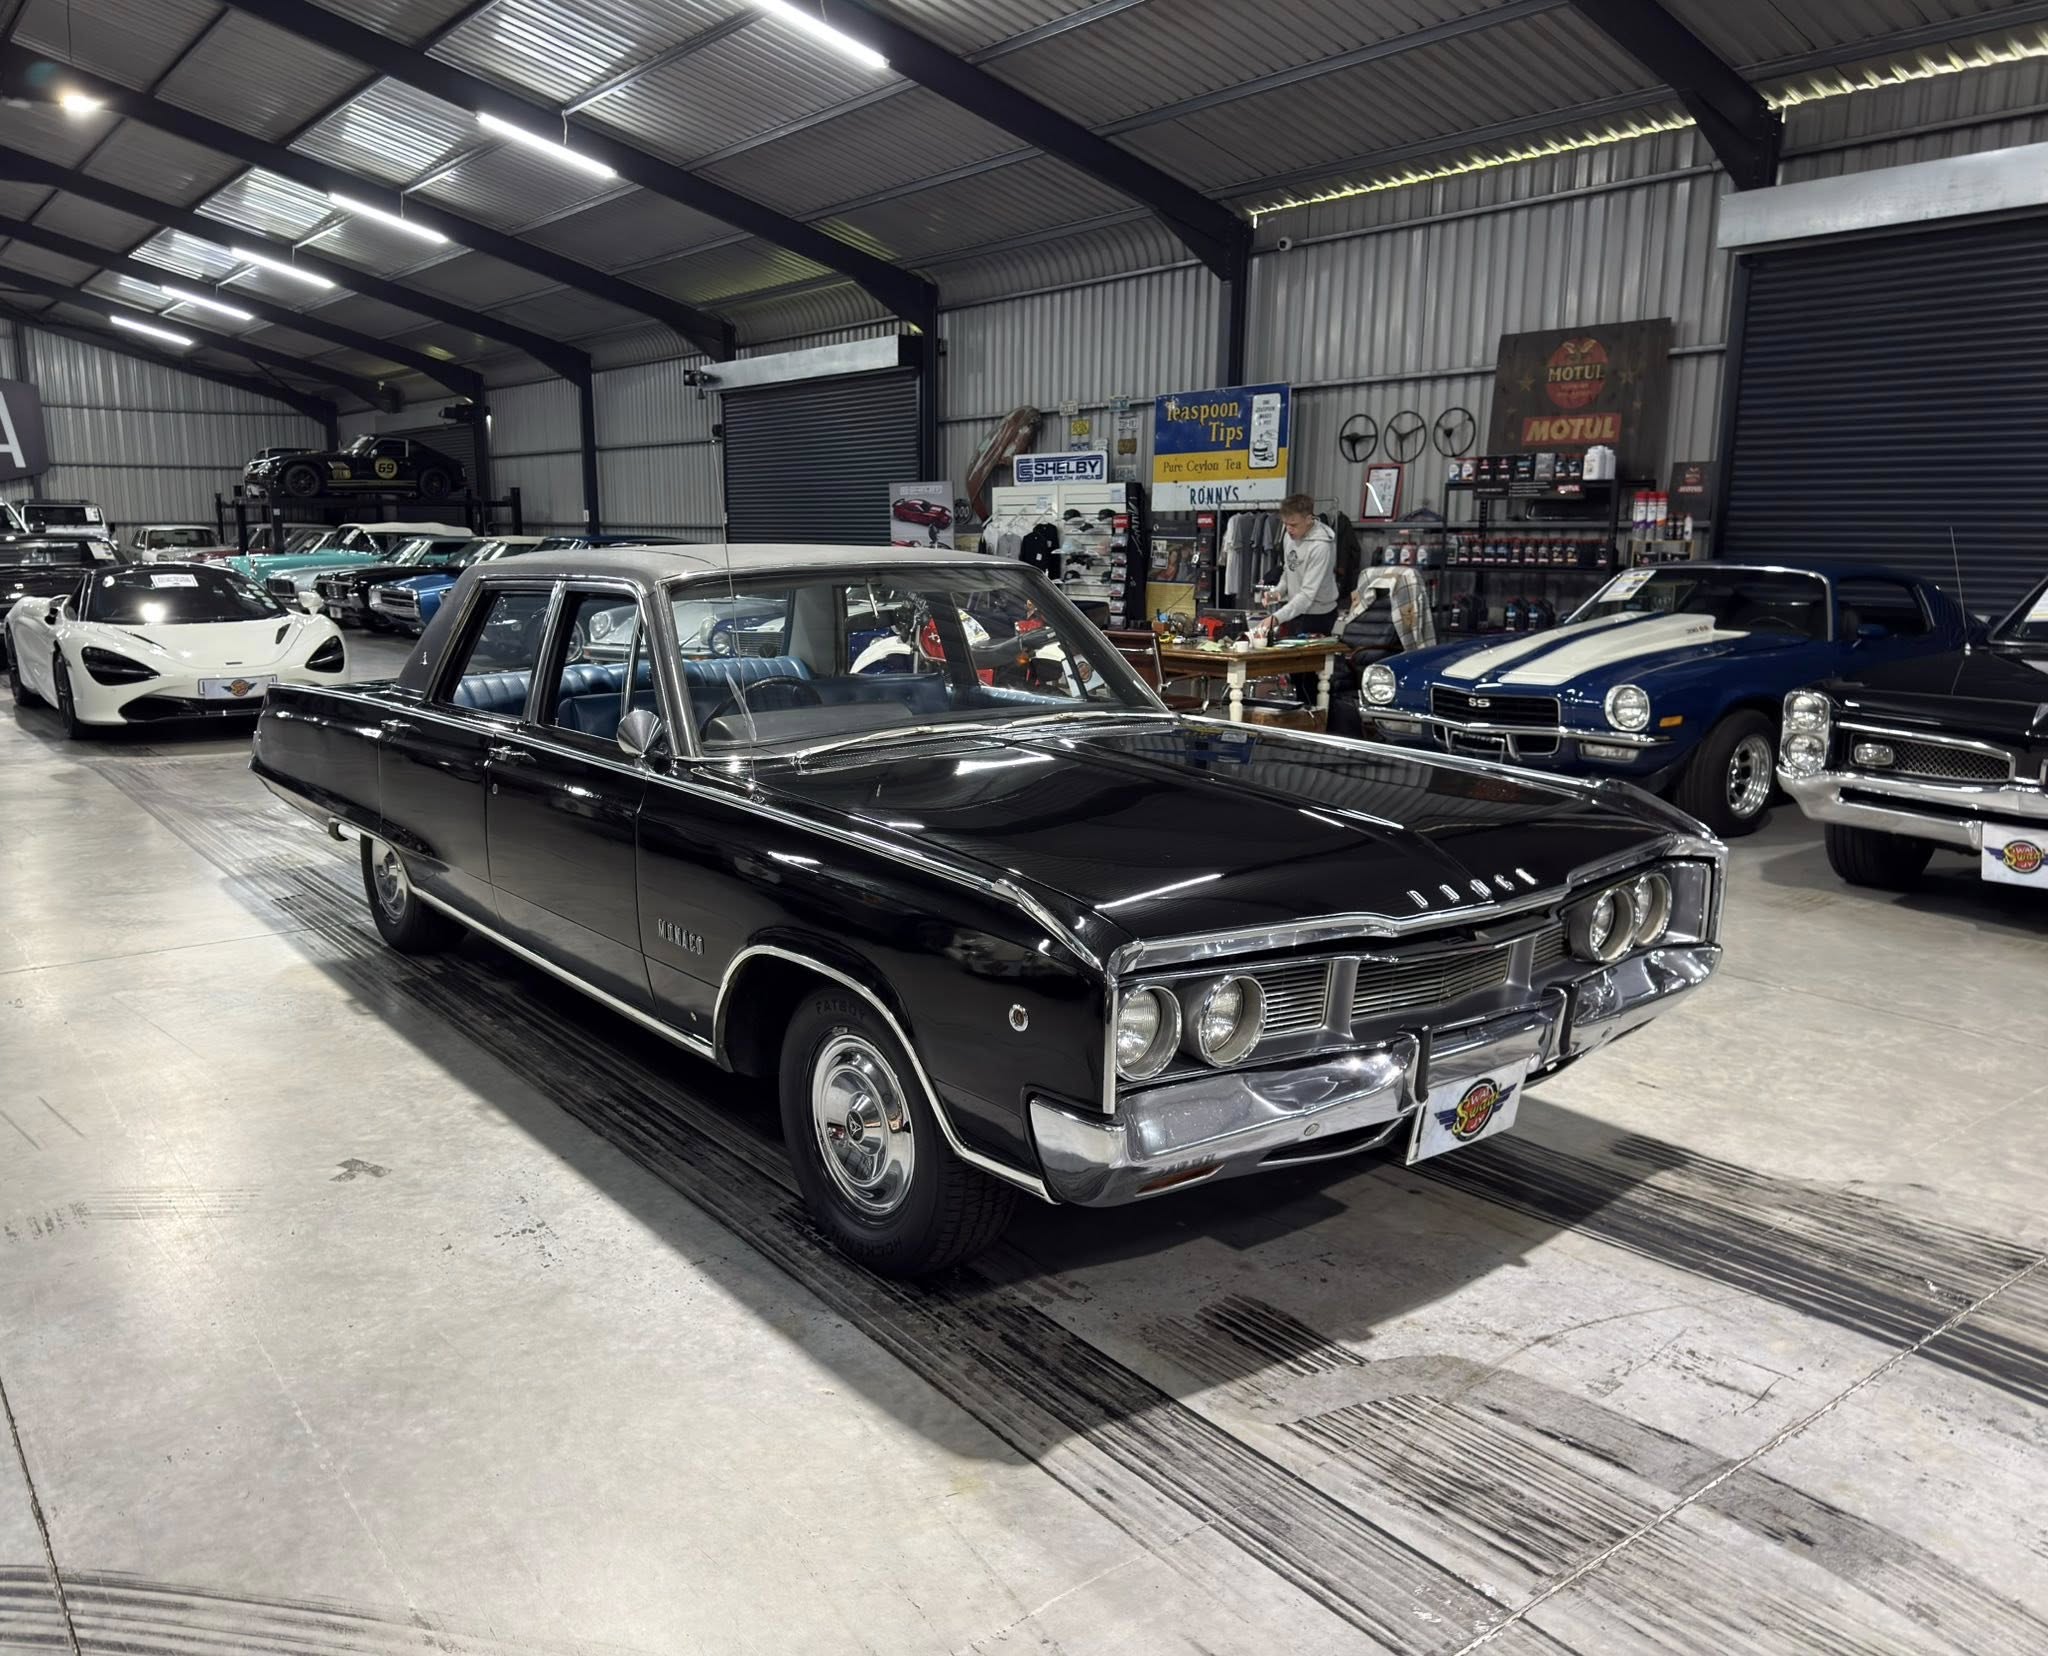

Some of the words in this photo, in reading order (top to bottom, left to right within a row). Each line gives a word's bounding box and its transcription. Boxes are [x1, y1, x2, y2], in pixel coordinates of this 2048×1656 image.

[1548, 364, 1606, 382] MOTUL
[1165, 400, 1239, 426] Teaspoon
[1209, 421, 1244, 448] Tips
[1526, 416, 1616, 442] MOTUL
[378, 463, 395, 474] 69
[1034, 460, 1100, 475] SHELBY
[1163, 462, 1183, 473] Pure
[1186, 460, 1219, 474] Ceylon
[1225, 459, 1241, 471] Tea
[1190, 485, 1240, 505] RONNYS
[1468, 697, 1490, 708] SS
